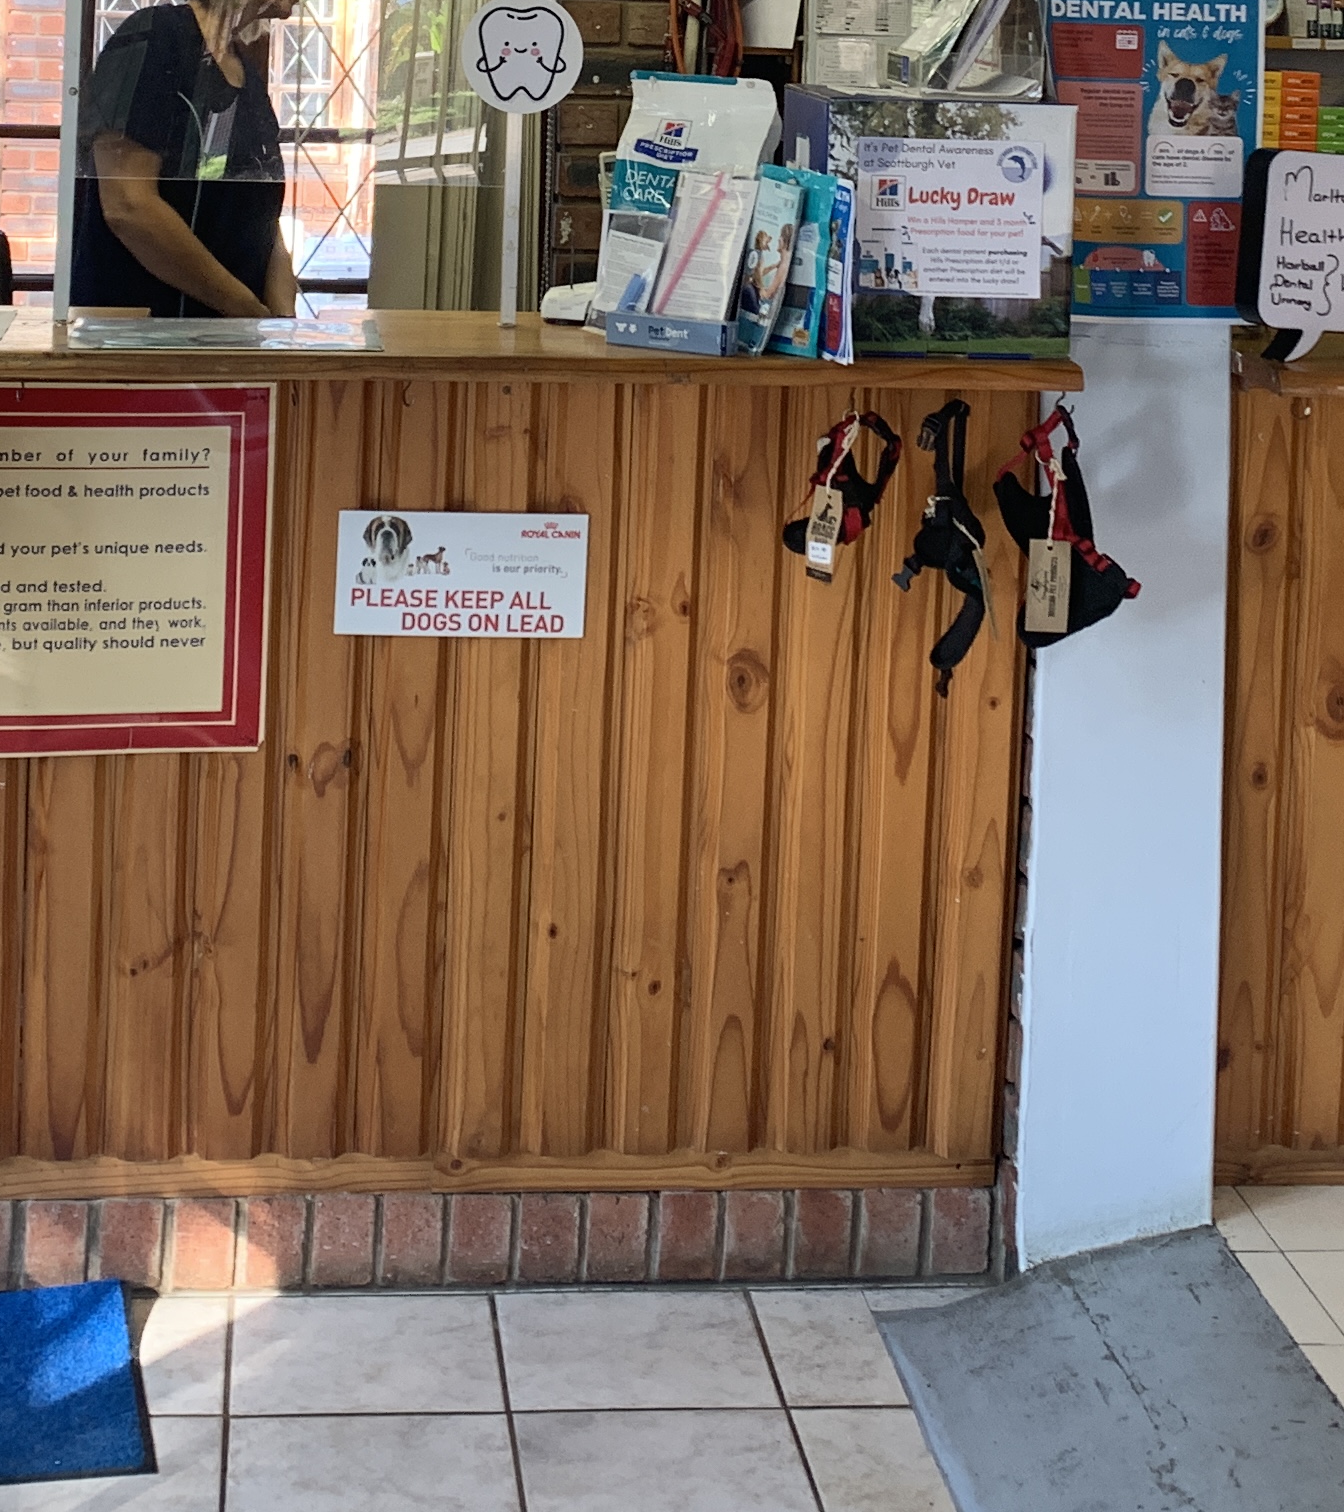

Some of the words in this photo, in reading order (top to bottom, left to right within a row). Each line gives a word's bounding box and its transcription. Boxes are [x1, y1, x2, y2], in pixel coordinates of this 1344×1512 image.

[1051, 0, 1146, 20] DENTAL
[1152, 2, 1247, 23] HEALTH
[1173, 24, 1196, 39] cats
[864, 142, 878, 153] It's
[882, 143, 899, 153] Pet
[902, 143, 936, 155] Dental
[939, 146, 994, 156] Awareness
[863, 158, 875, 168] at
[877, 158, 934, 171] Scottburgh
[938, 160, 956, 169] Vet
[908, 186, 961, 210] Lucky
[967, 188, 1015, 206] Draw
[1270, 274, 1313, 291] Dental
[56, 448, 74, 463] of
[87, 450, 129, 466] your
[142, 447, 211, 464] family?
[25, 484, 63, 498] food
[67, 484, 79, 498] &
[84, 484, 134, 498] health
[139, 484, 210, 499] products
[521, 529, 549, 539] ROYAL
[551, 531, 581, 540] CANIN
[10, 543, 46, 559] your
[51, 542, 90, 558] pet's
[95, 542, 150, 558] unique
[154, 541, 208, 556] needs.
[350, 588, 438, 608] PLEASE
[445, 590, 504, 609] KEEP
[509, 591, 552, 611] ALL
[401, 613, 461, 631] DOGS
[468, 614, 499, 632] ON
[506, 614, 565, 634] LEAD
